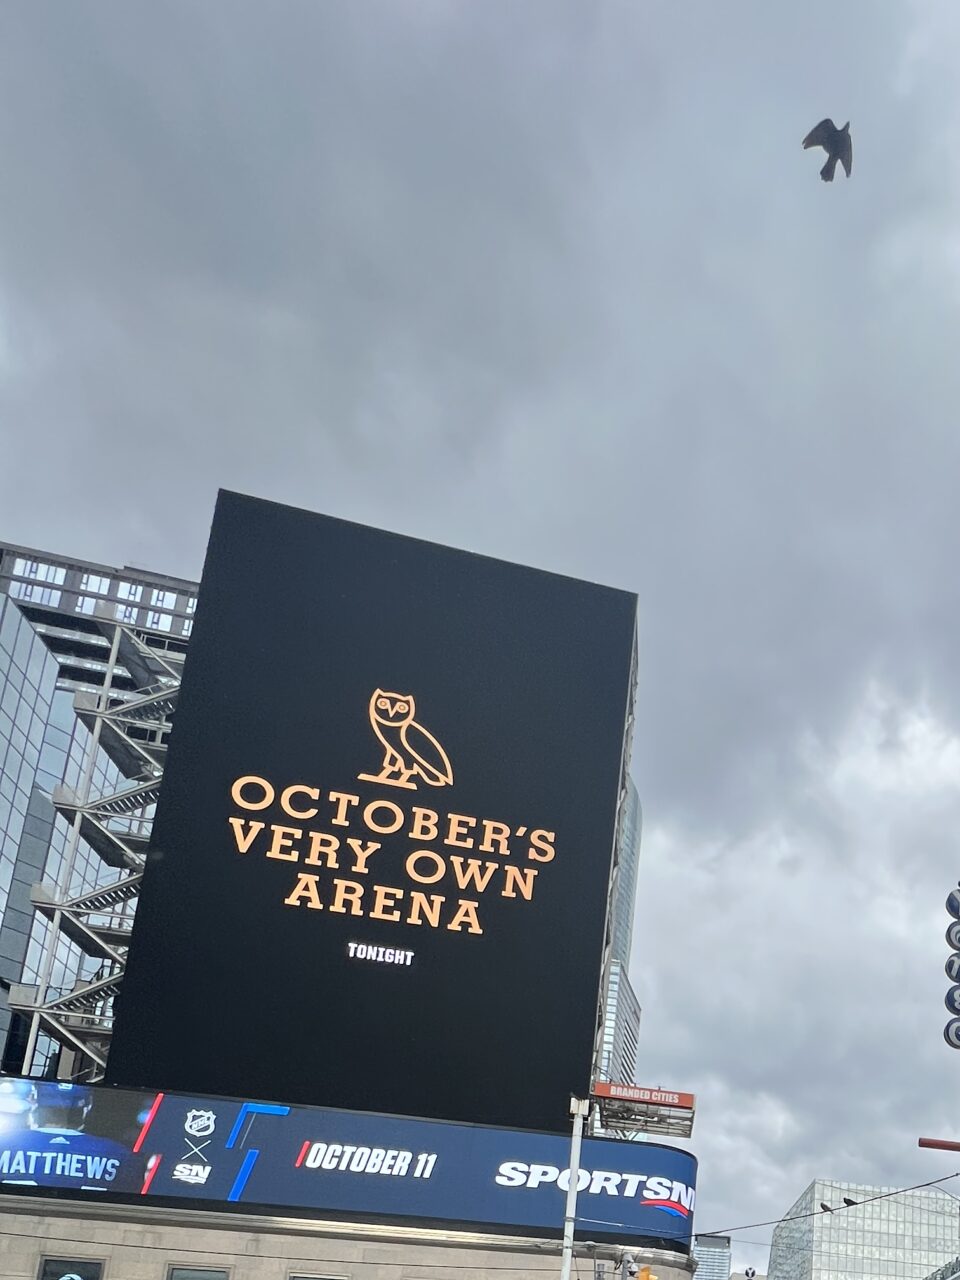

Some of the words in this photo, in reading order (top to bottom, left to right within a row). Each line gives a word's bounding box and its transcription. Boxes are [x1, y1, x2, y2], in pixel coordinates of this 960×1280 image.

[230, 774, 558, 865] OCTOBER'S
[228, 816, 383, 875] VERY
[405, 849, 539, 901] OWN
[283, 872, 484, 935] ARENA
[347, 942, 416, 967] TONIGHT
[610, 1085, 651, 1100] BRANDED
[651, 1090, 680, 1104] CITIES
[173, 1163, 212, 1179] SN
[305, 1142, 413, 1177] OCTOBER
[416, 1153, 438, 1179] 11
